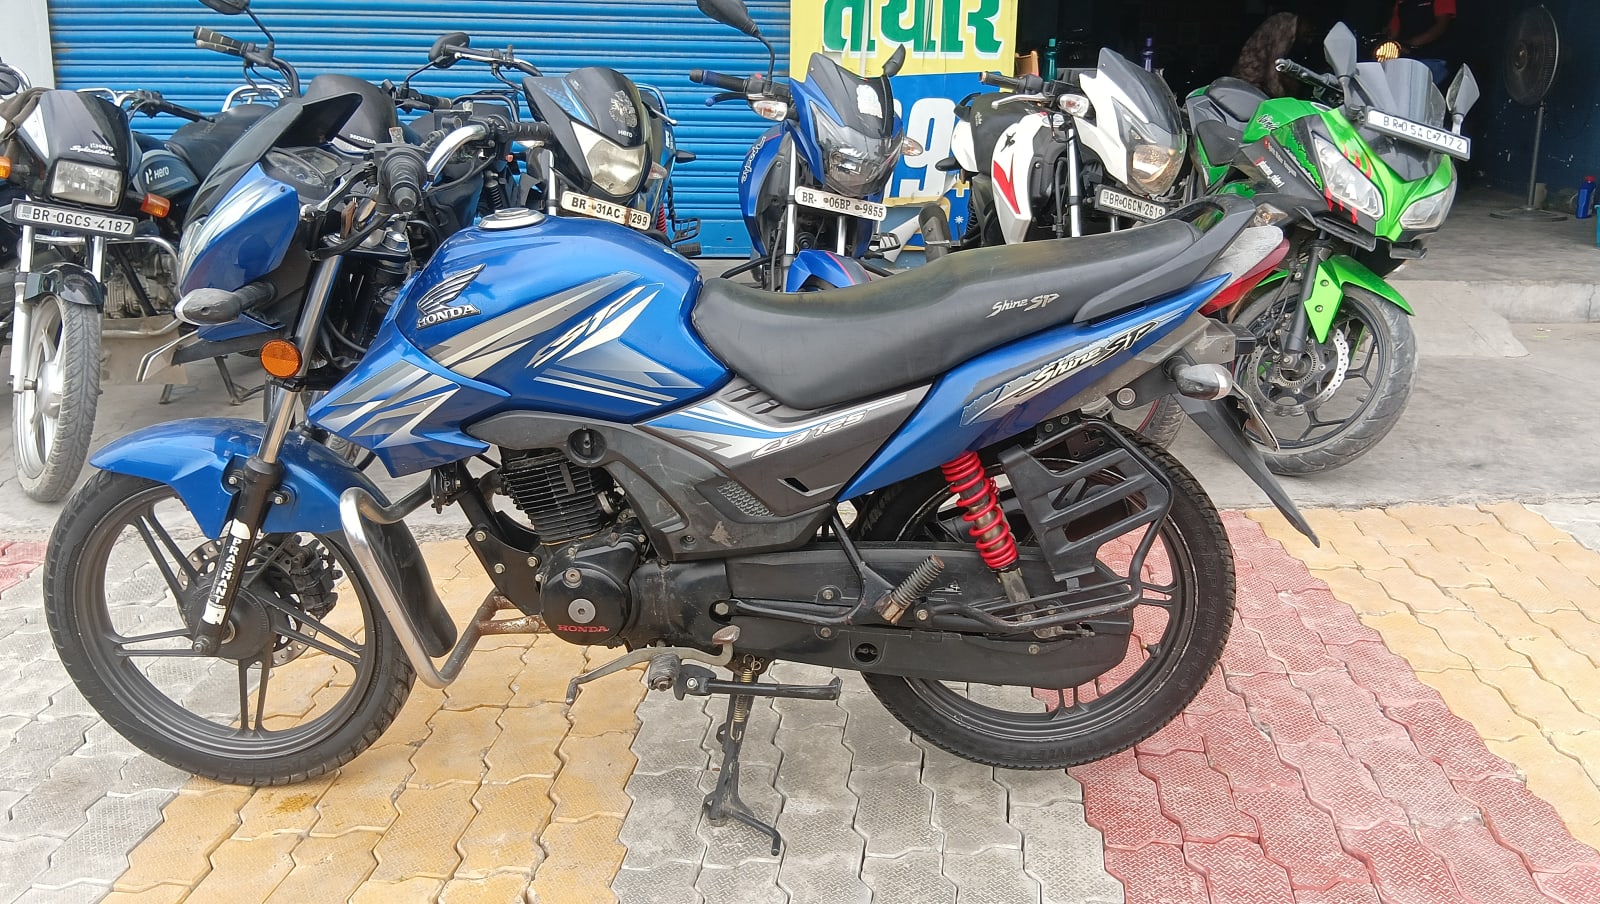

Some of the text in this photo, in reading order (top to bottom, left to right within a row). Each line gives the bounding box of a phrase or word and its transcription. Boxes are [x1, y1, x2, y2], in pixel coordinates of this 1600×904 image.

[416, 304, 479, 329] HONDA
[985, 293, 1060, 319] Shine SP
[1014, 347, 1102, 398] Shine
[214, 536, 243, 604] PRASHANT
[557, 624, 610, 633] HONDA
